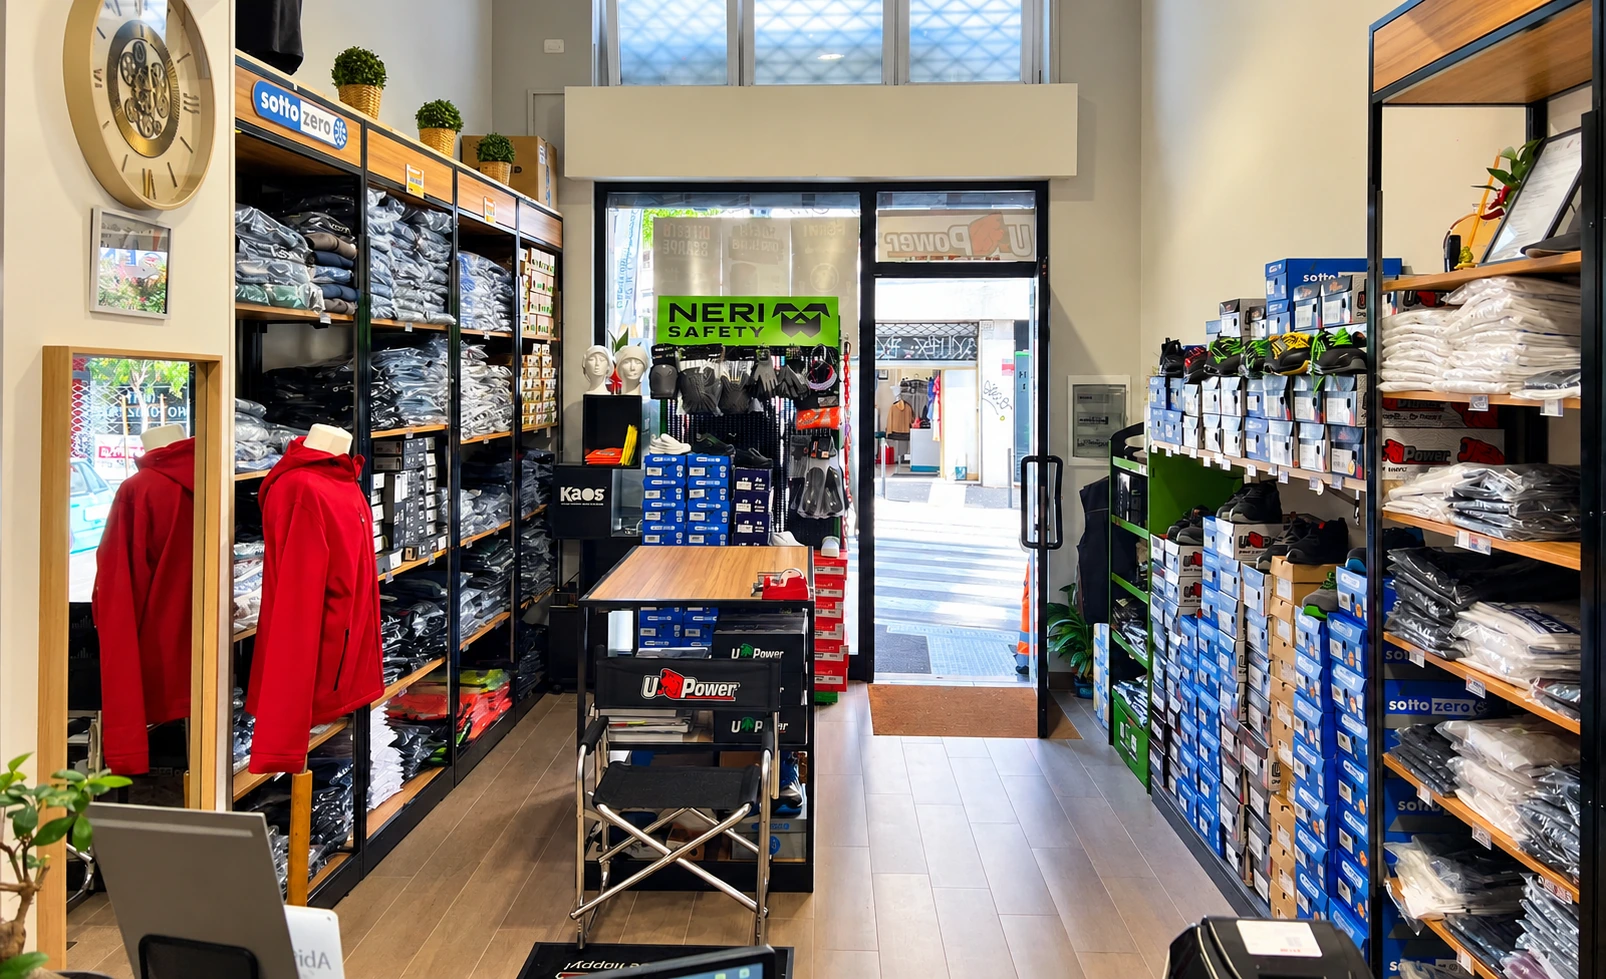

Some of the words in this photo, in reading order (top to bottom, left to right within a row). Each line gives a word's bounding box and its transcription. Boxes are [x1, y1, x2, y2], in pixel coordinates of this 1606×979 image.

[261, 91, 299, 122] sotto
[302, 109, 331, 135] zero
[669, 302, 765, 323] NERI
[668, 325, 765, 338] SAFETY
[1403, 446, 1451, 462] Power
[560, 486, 605, 502] Kaos
[731, 648, 741, 659] U
[752, 648, 784, 659] Power
[641, 676, 661, 698] U
[680, 677, 739, 698] Power
[1388, 699, 1430, 711] sotto
[1434, 702, 1470, 713] zero
[731, 720, 742, 733] U
